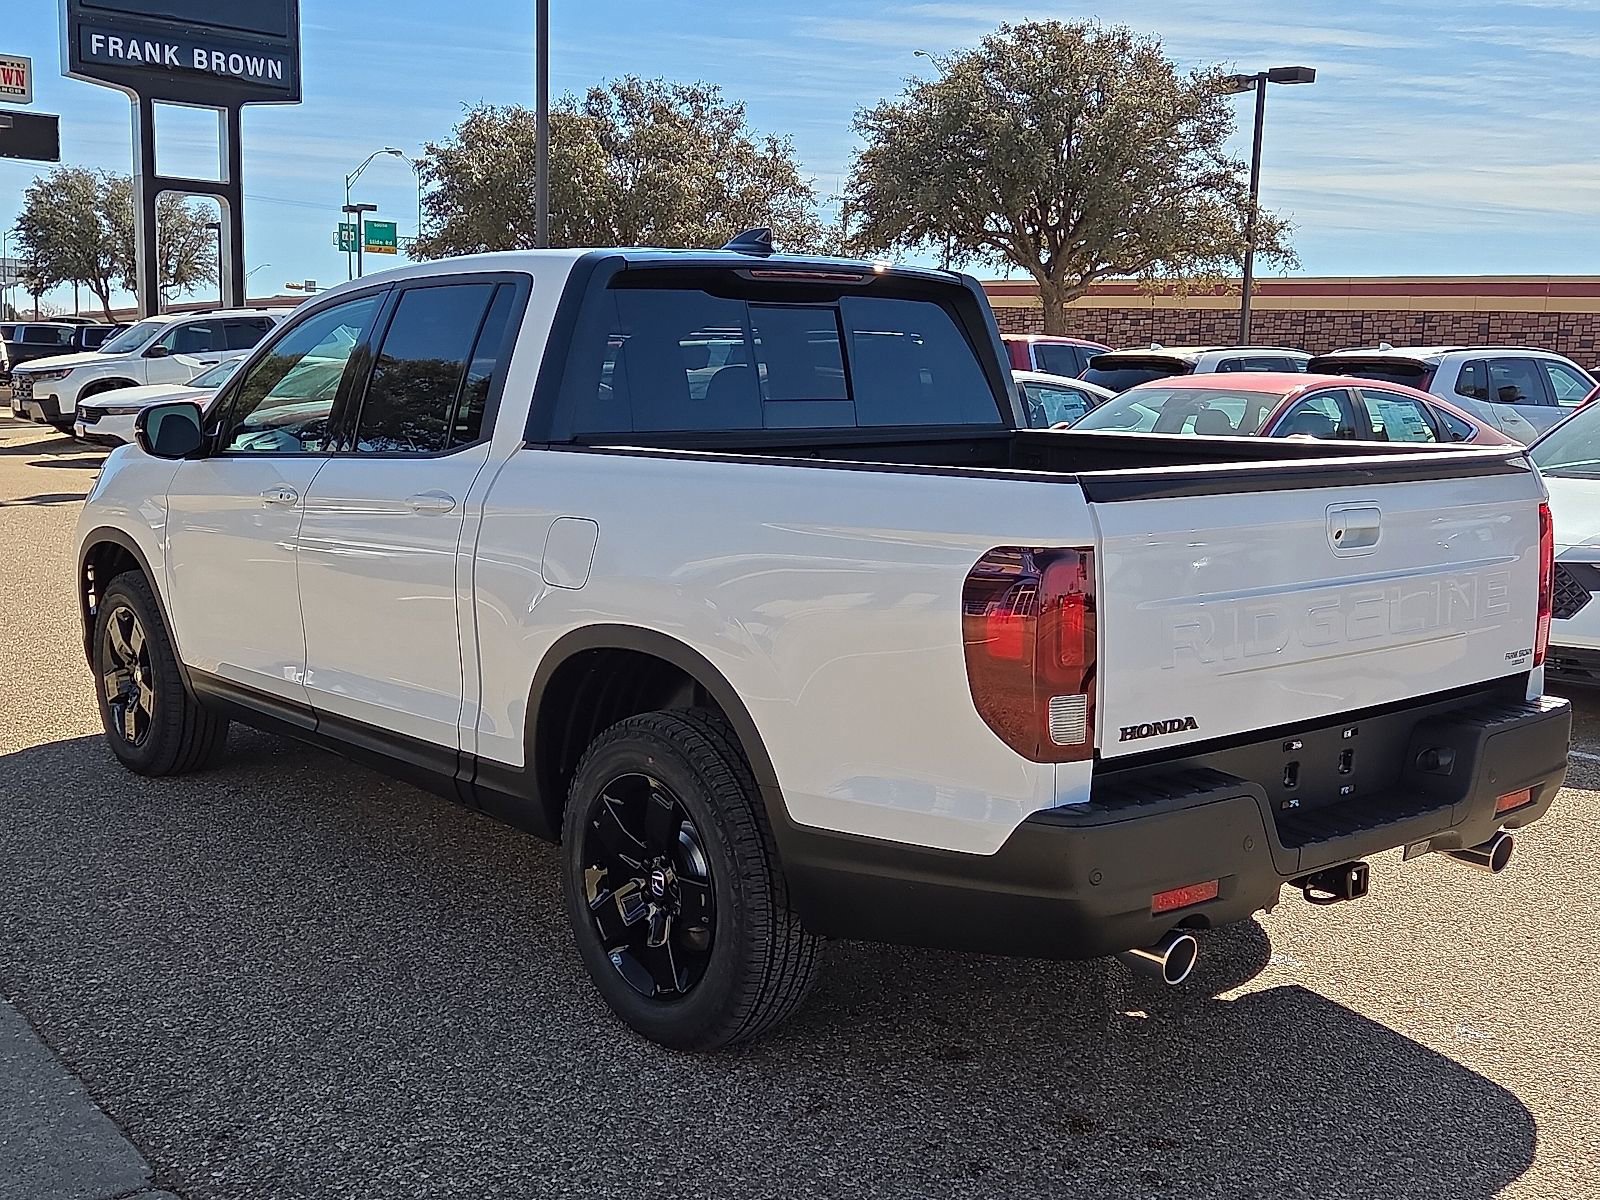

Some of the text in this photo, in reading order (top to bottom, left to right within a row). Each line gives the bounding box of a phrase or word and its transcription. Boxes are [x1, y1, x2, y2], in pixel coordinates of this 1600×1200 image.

[91, 34, 282, 80] FRANK BROWN
[1161, 571, 1512, 670] RIDGELINE
[1119, 716, 1199, 742] HONDA
